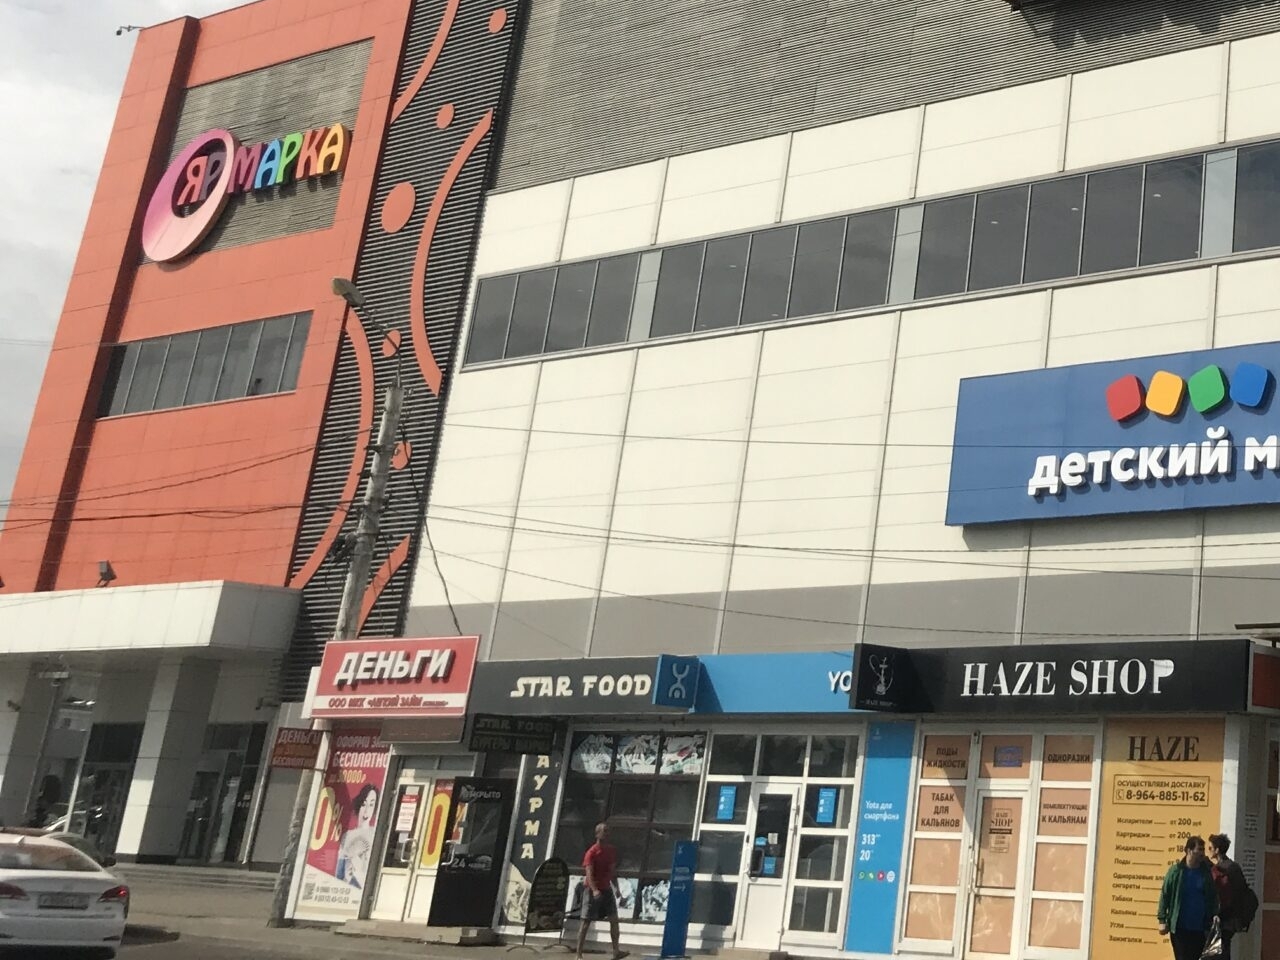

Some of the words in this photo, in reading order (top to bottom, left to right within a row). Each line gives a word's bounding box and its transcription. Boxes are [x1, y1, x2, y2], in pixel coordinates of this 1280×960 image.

[1027, 426, 1233, 496] детский
[333, 649, 453, 687] ДЕНЬГИ
[960, 661, 1057, 697] HAZE
[1069, 658, 1175, 696] SHOP
[510, 675, 574, 697] STAR
[582, 674, 652, 696] FOOD
[328, 698, 346, 708] ООО
[936, 747, 958, 755] ПОДЫ
[1127, 736, 1200, 762] HAZE
[333, 751, 389, 768] БЕСПЛАТНО
[1047, 753, 1091, 763] ОДНОРАЗКИ
[926, 759, 966, 769] ЖИДКОСТИ
[1117, 780, 1170, 789] ОСУЩЕСТВЛЯЕМ
[1171, 781, 1206, 789] ДОСТАВКУ
[931, 792, 955, 802] ТАБАК
[1126, 790, 1206, 802] 8-964-885-11-62
[933, 805, 949, 815] ДЛЯ
[920, 818, 960, 828] КАЛЬЯНОВ
[990, 818, 1013, 827] SHOP
[1042, 815, 1047, 824] К
[1048, 815, 1087, 825] КАЛЬЯНАМ
[1178, 818, 1192, 826] 200
[1177, 831, 1191, 839] 200
